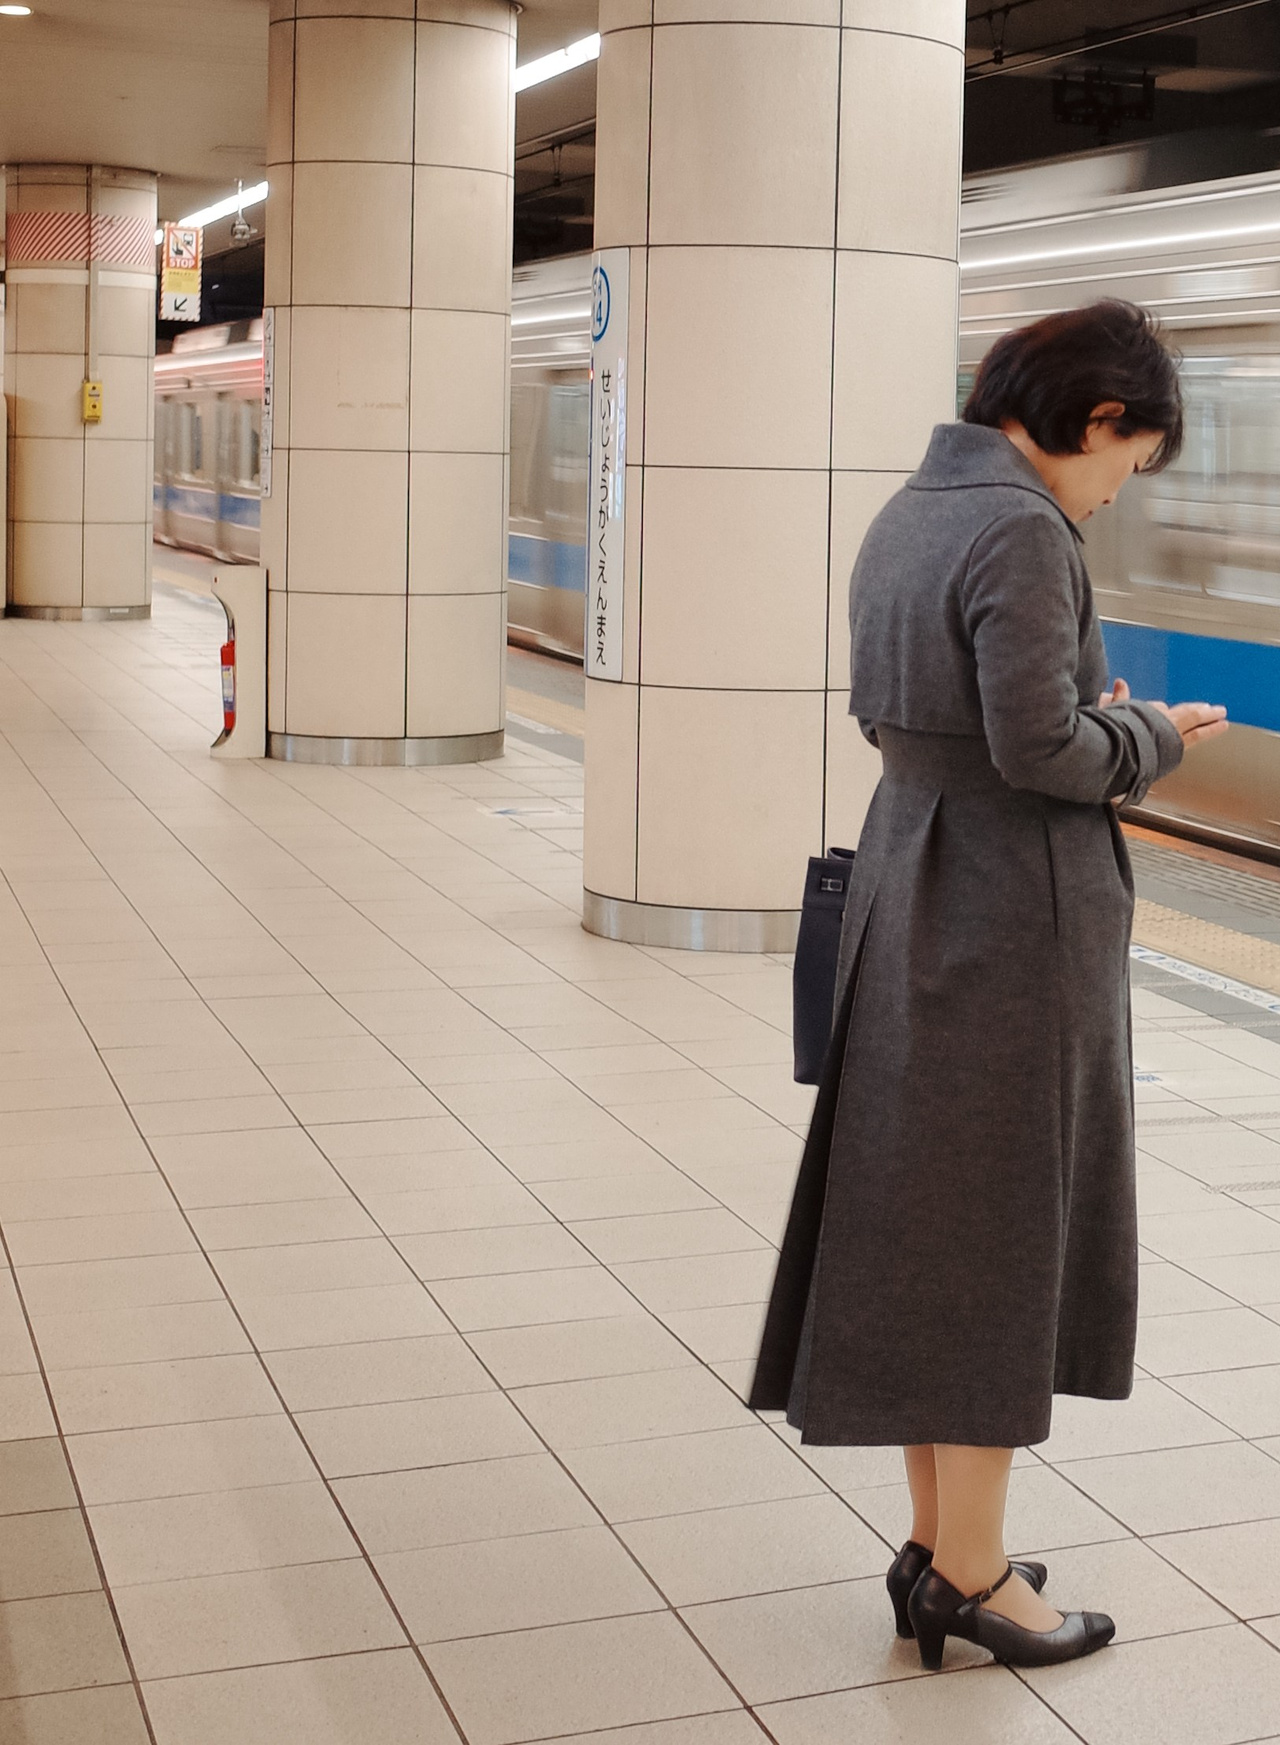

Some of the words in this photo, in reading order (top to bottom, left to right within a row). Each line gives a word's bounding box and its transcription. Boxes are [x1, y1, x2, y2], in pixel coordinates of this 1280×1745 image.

[169, 257, 196, 269] STOP
[596, 368, 612, 666] せいじょうがくえんまえ
